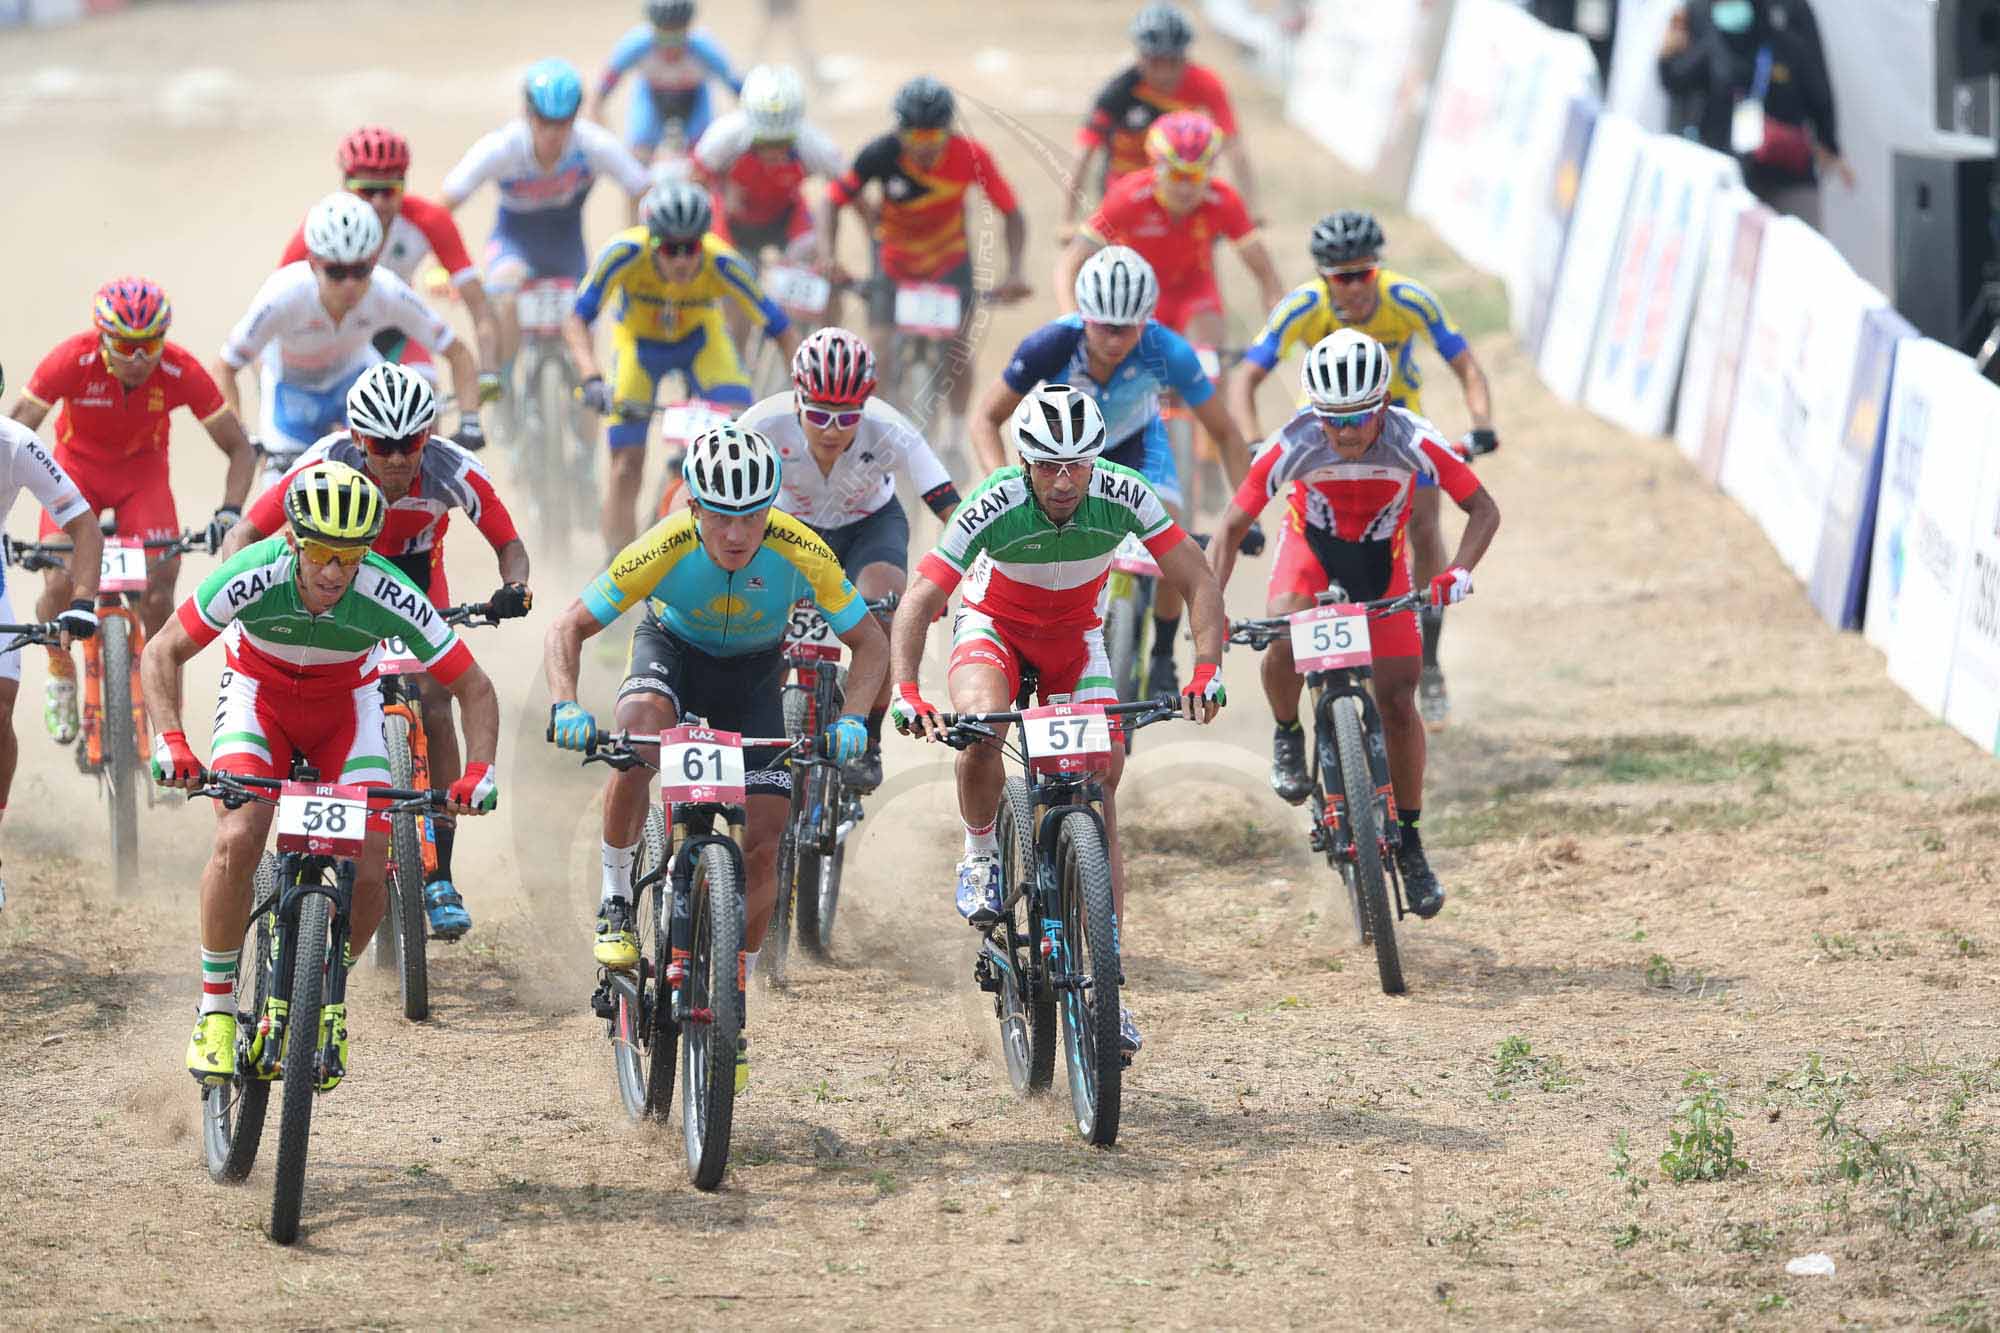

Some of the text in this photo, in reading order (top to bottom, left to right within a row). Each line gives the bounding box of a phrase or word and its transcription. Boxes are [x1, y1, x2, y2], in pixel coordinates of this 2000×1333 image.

[27, 441, 62, 484] KOREA
[1100, 472, 1147, 510] IRAN
[957, 486, 1010, 535] IRAN
[613, 529, 692, 580] KAZAKHSTAN
[374, 577, 433, 627] IRAN
[1313, 622, 1352, 652] 55
[1055, 706, 1072, 716] IRI
[688, 729, 716, 741] KAZ
[1048, 719, 1089, 750] 57
[683, 747, 722, 782] 61
[316, 786, 333, 796] IRI
[302, 801, 346, 832] 58
